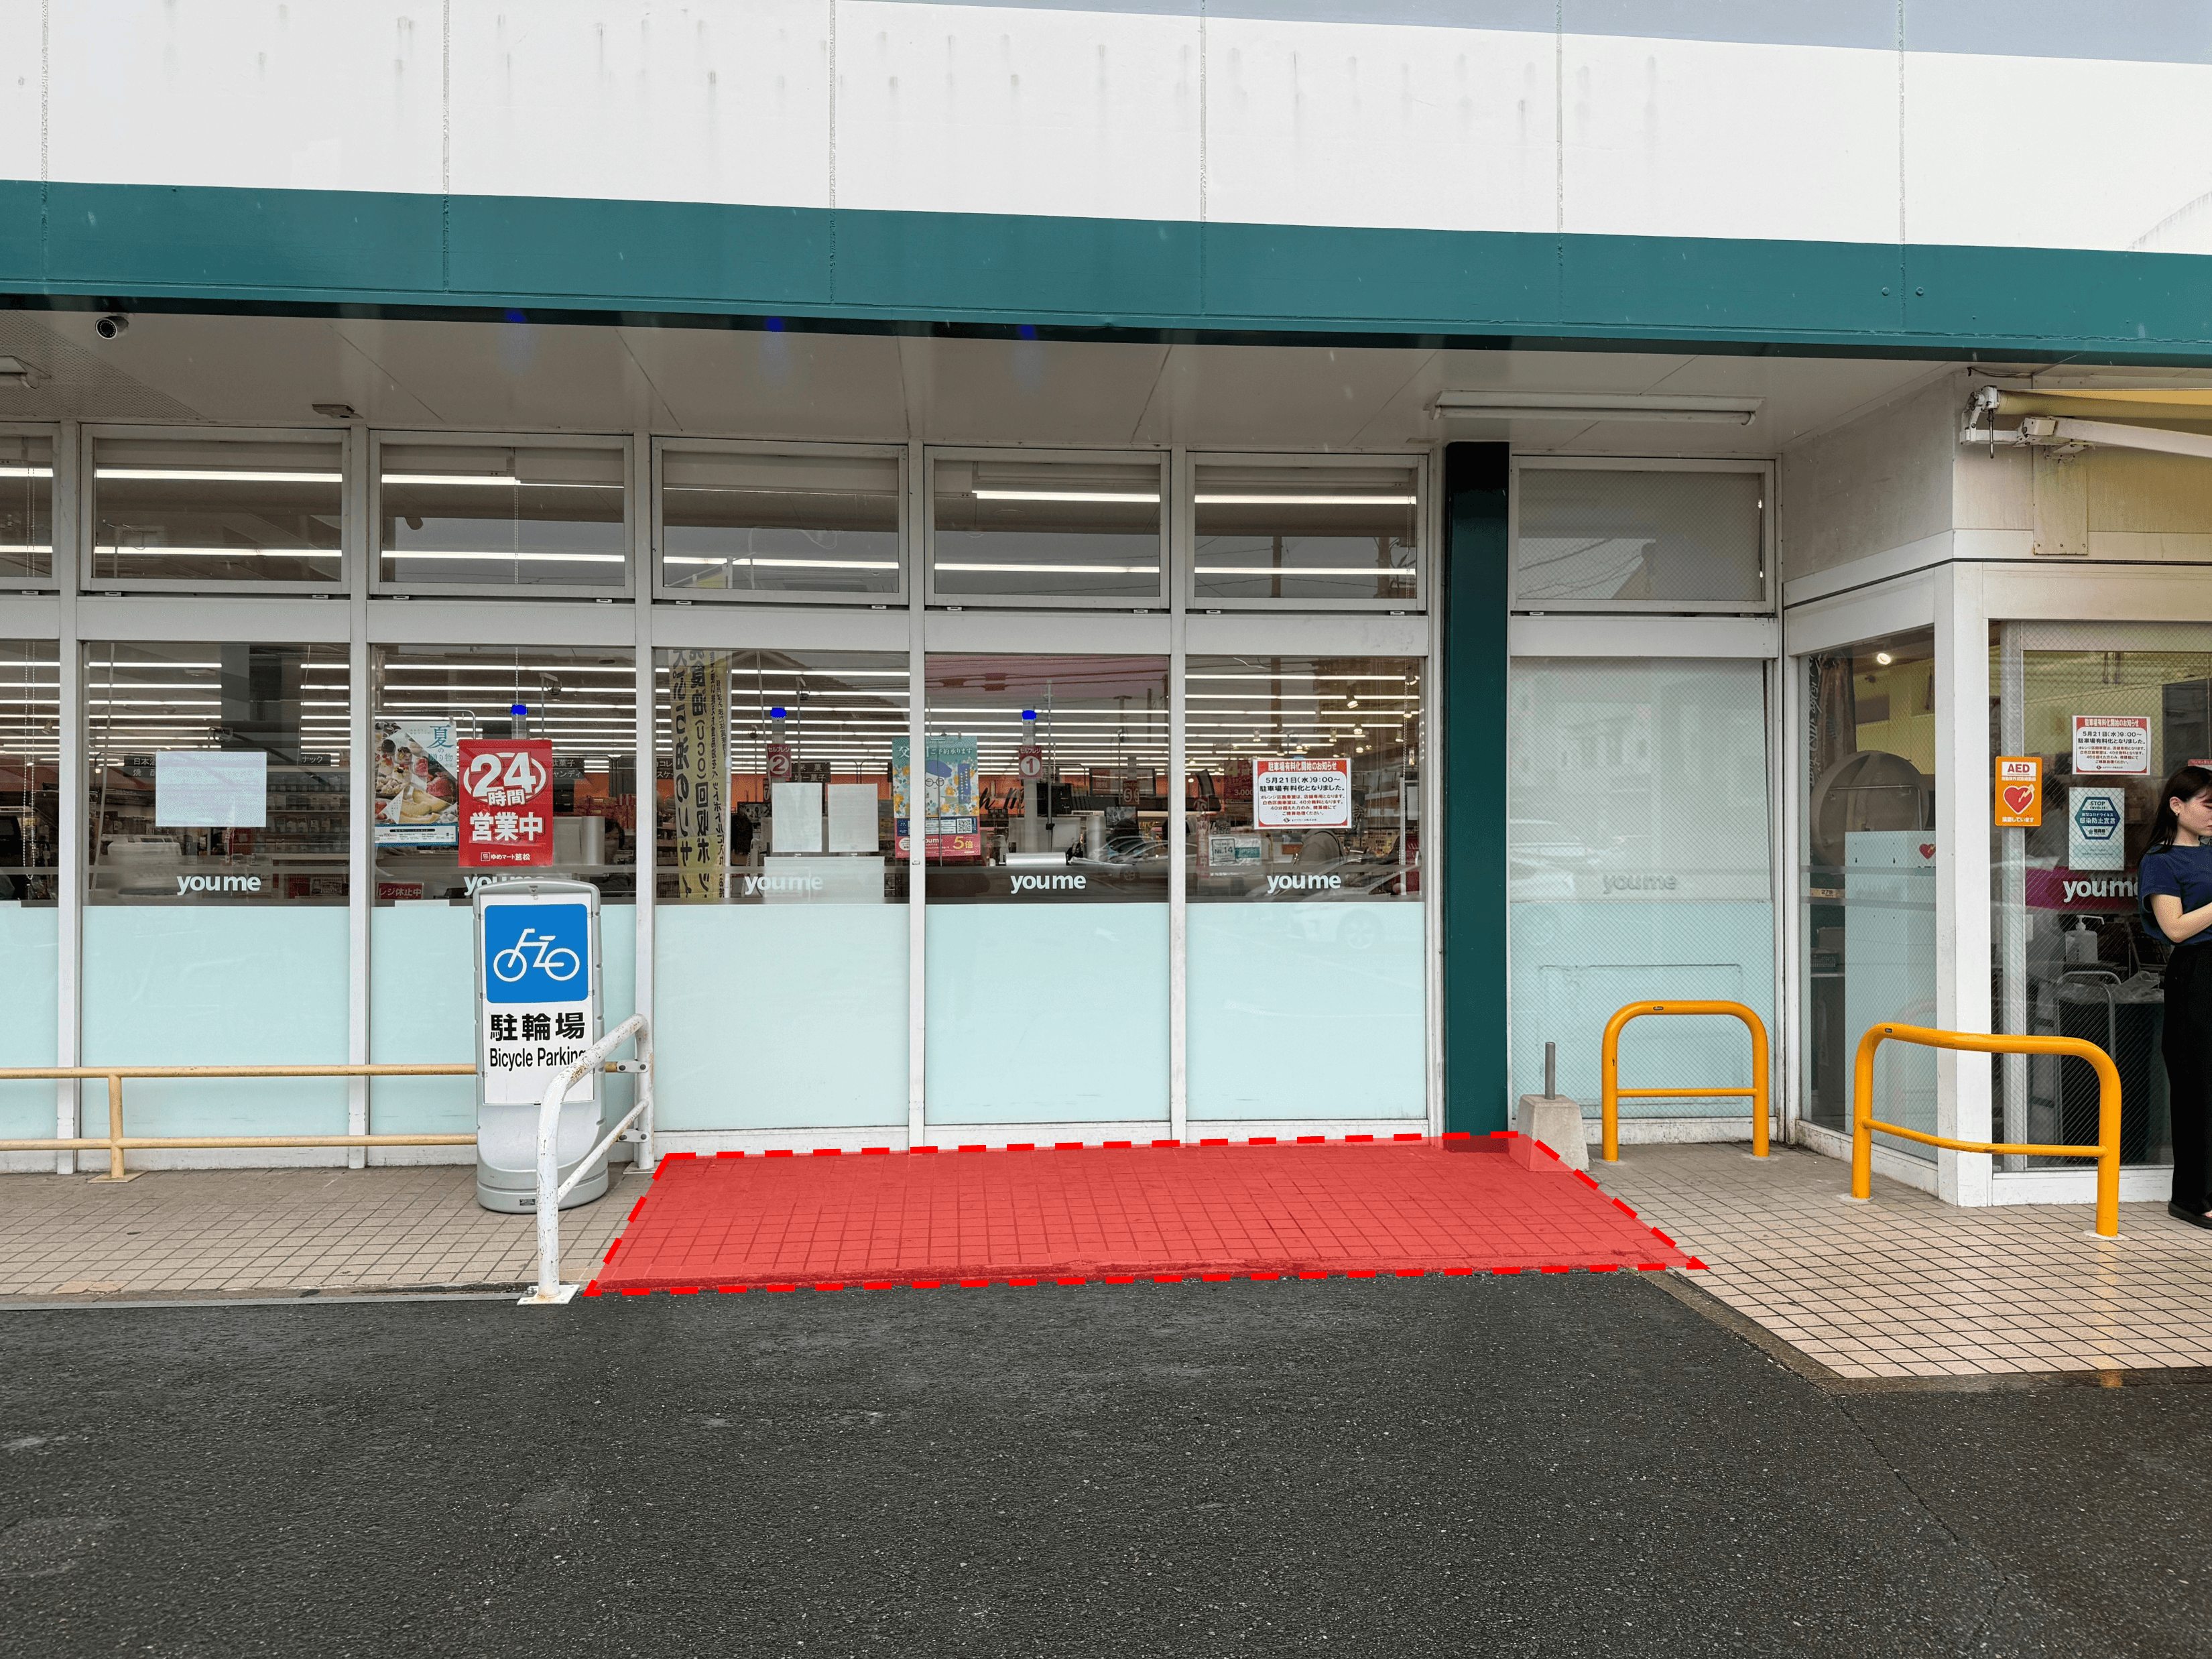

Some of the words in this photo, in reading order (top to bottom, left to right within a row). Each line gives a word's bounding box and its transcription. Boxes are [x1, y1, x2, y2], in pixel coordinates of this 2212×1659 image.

[426, 724, 455, 749] 夏
[471, 751, 537, 797] 24
[1268, 761, 1337, 771] 駐車場有料化開始のお知らせ
[2008, 763, 2030, 773] AED
[487, 789, 526, 806] 時間
[470, 812, 544, 842] 営業中
[176, 875, 261, 896] youme
[379, 888, 422, 896] レジ休止中
[745, 876, 824, 896] youme
[1010, 874, 1087, 894] youme
[1266, 873, 1341, 894] youme
[2063, 880, 2138, 903] youm
[490, 1012, 585, 1042] 駐輪場
[490, 1048, 534, 1072] Bicycle
